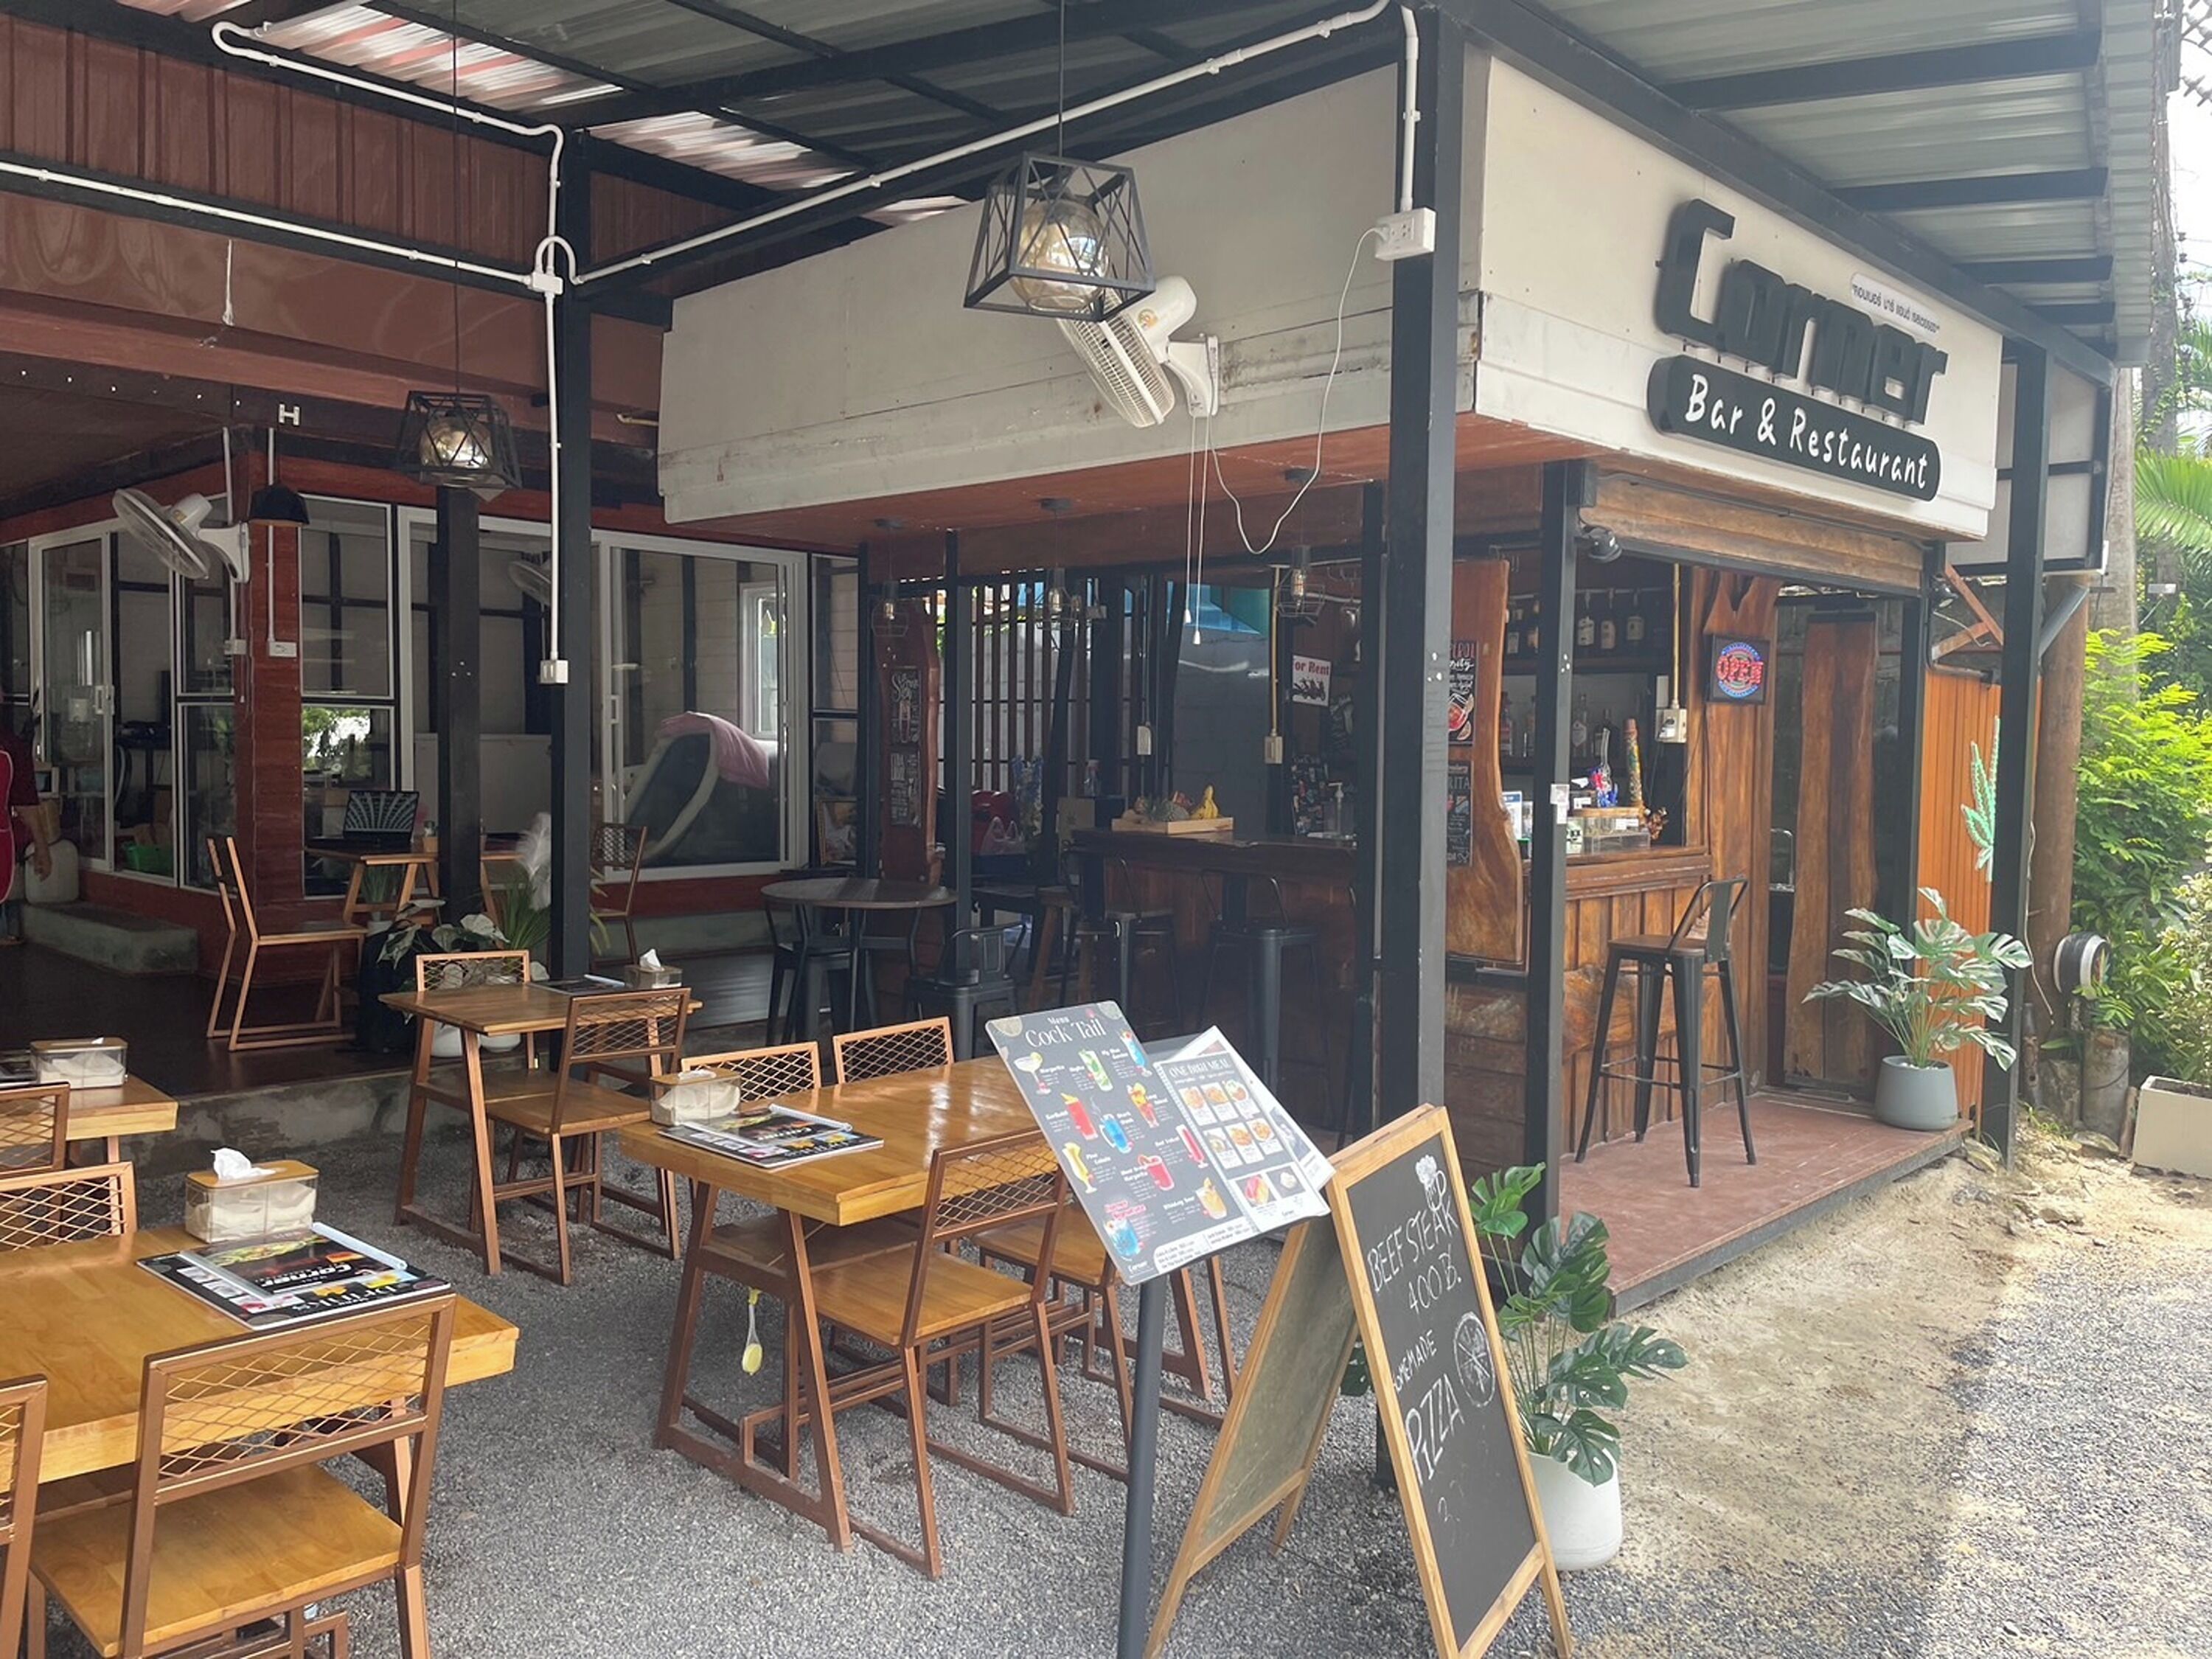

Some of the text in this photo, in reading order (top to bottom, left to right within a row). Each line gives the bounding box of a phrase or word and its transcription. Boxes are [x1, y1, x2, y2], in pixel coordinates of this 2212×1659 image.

[1656, 198, 1949, 425] Corner
[1685, 374, 1928, 489] Bar & Restaurant
[1295, 661, 1329, 676] or Rent
[1716, 655, 1763, 685] OPEN
[1025, 1018, 1107, 1048] Cock Tail
[1367, 1194, 1459, 1293] BEEF STEAK
[1409, 1265, 1443, 1314] 400
[1393, 1329, 1437, 1394] OMEMADE
[1405, 1374, 1465, 1486] PIZZA
